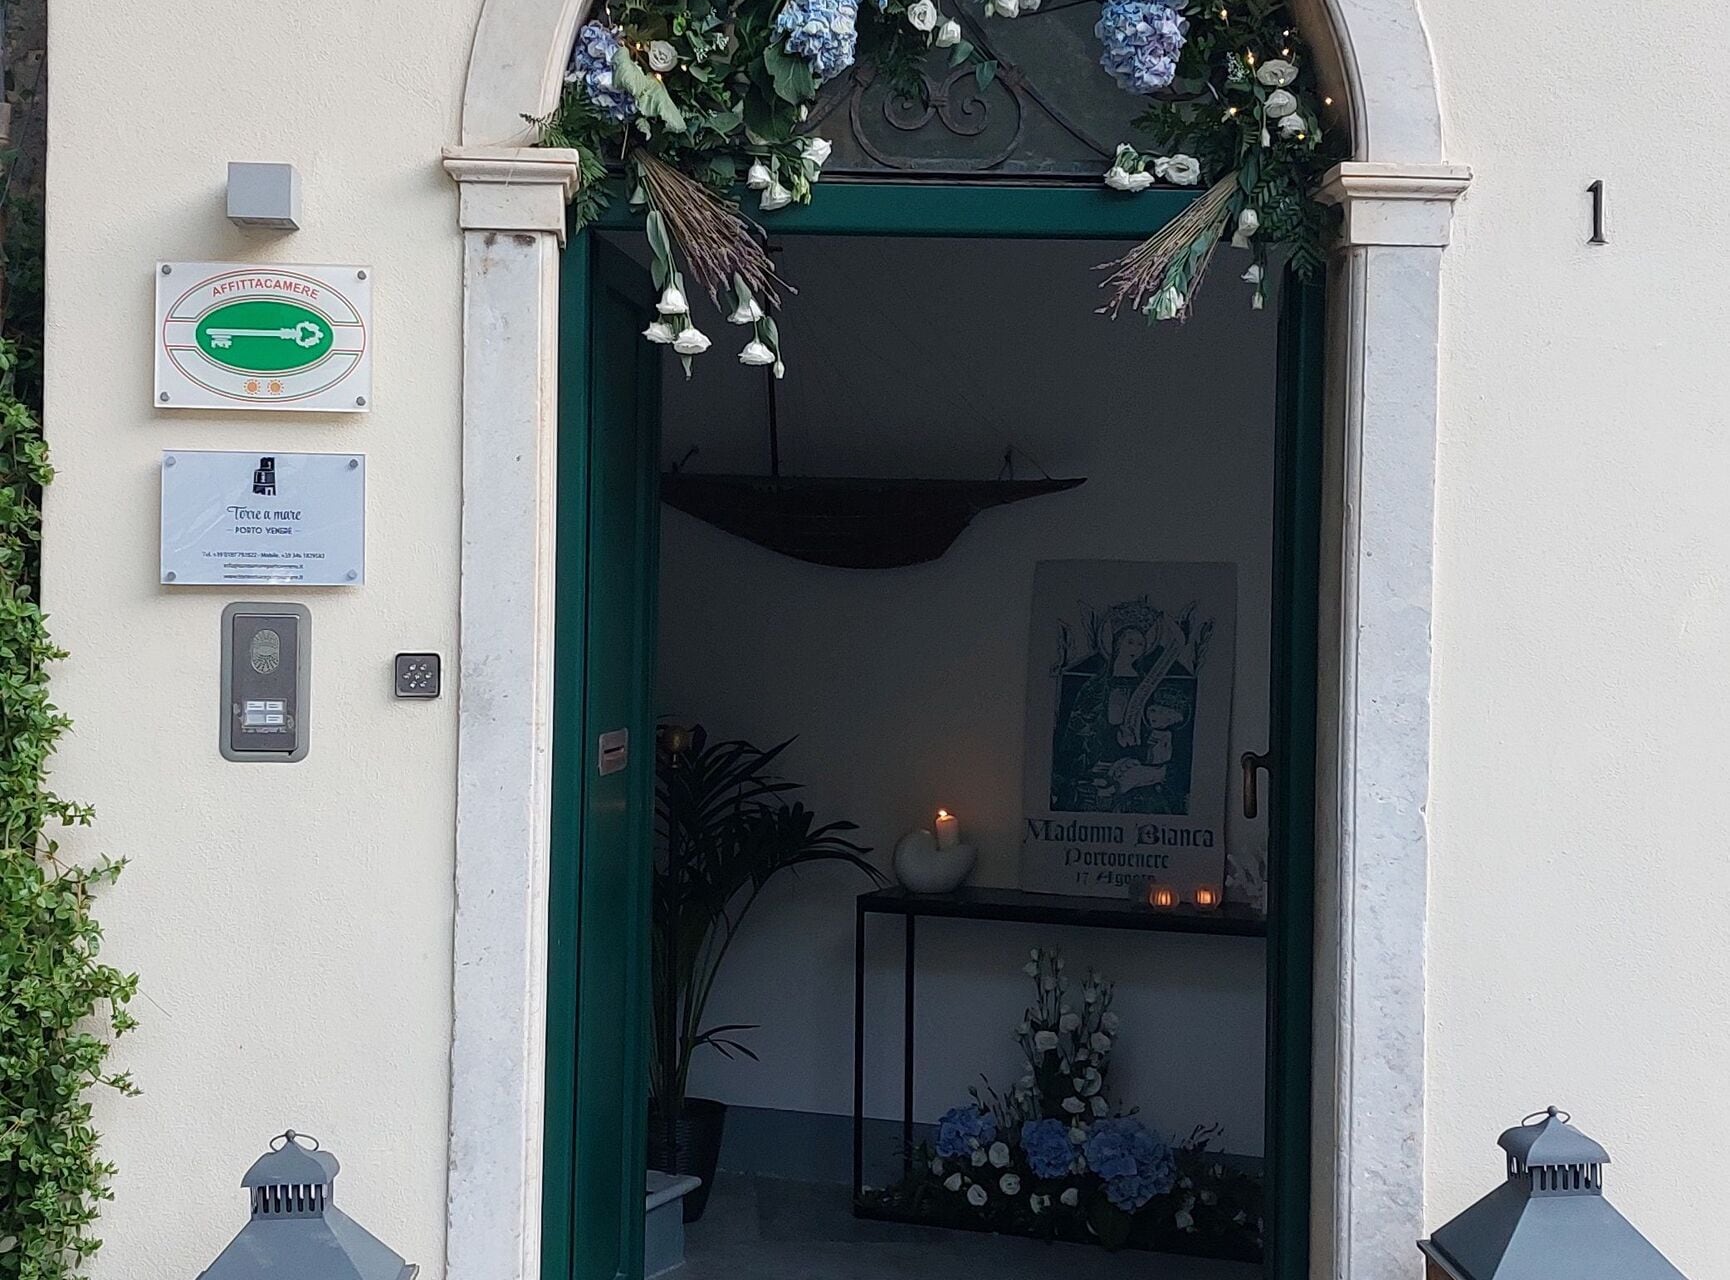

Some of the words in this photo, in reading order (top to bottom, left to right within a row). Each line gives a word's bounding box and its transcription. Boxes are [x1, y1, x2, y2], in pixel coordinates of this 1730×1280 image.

[1585, 179, 1609, 246] 1
[212, 278, 320, 300] AFFITTACAMERE
[226, 505, 261, 521] Torre
[263, 510, 271, 520] a
[273, 510, 302, 521] mare
[235, 526, 263, 534] PORTO
[1023, 817, 1124, 844] Madonna
[1135, 823, 1215, 848] Bianca
